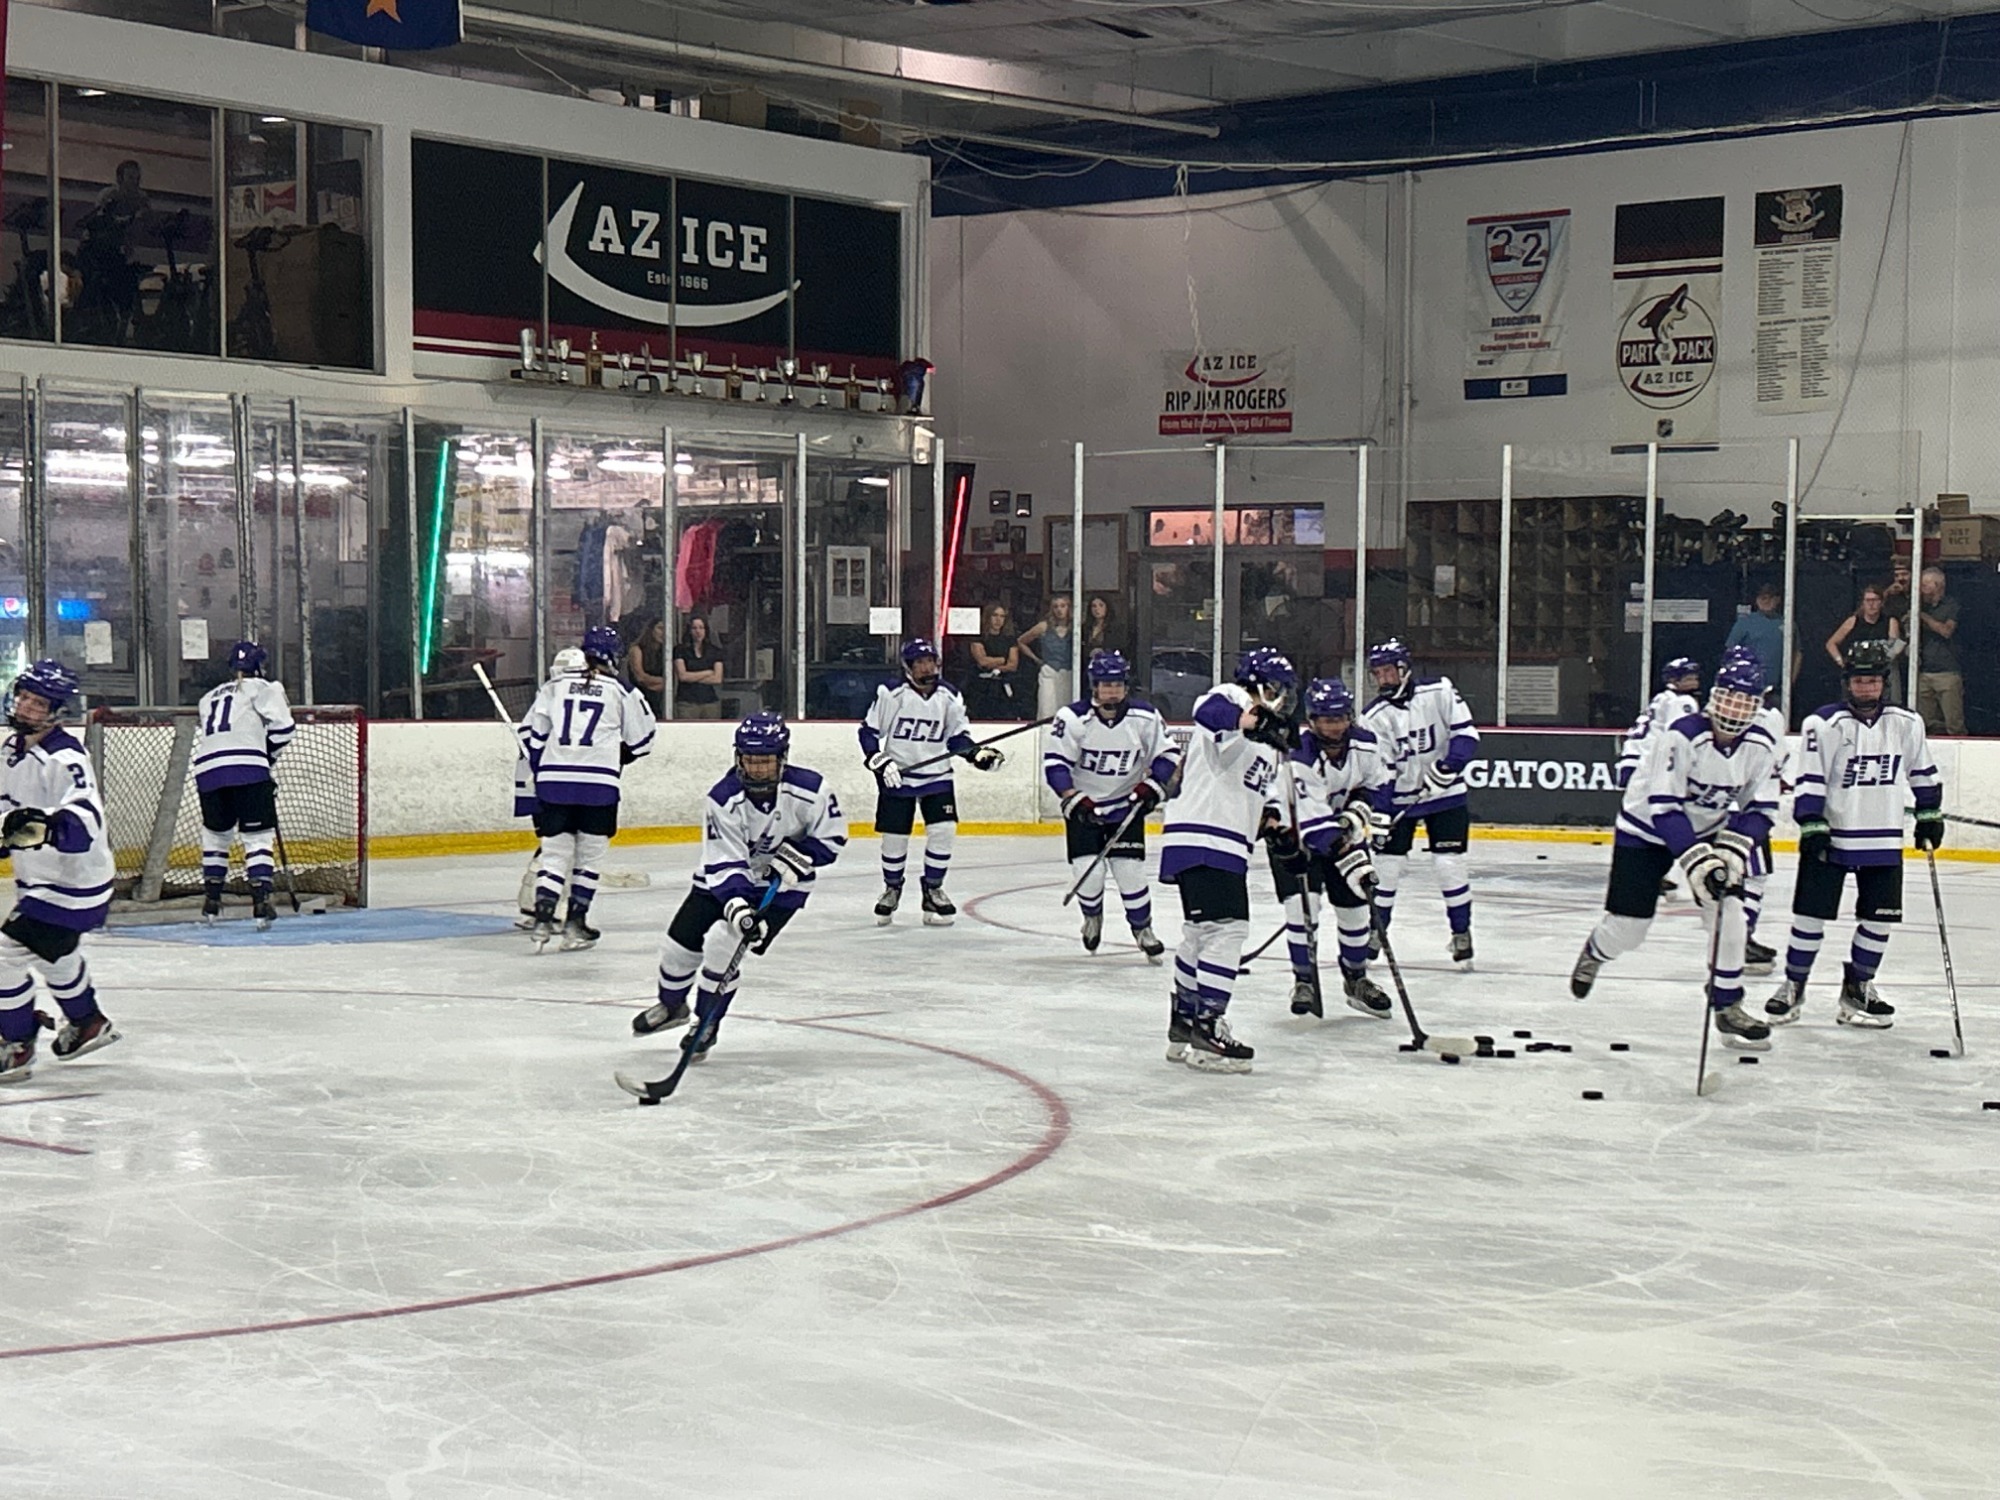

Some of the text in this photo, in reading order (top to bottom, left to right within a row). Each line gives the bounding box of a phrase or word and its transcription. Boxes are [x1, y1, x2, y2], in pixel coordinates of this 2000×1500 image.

[588, 205, 768, 273] AZ ICE
[680, 275, 709, 290] 1966
[1203, 355, 1257, 370] AZ ICE
[1622, 343, 1655, 364] PART
[1679, 338, 1713, 361] PACK
[1643, 371, 1694, 385] AZ ICE
[1165, 388, 1287, 411] RIP JIM ROGERS
[205, 694, 234, 737] 11
[558, 698, 605, 747] 17
[893, 717, 945, 743] GCU
[1079, 747, 1141, 776] GCU
